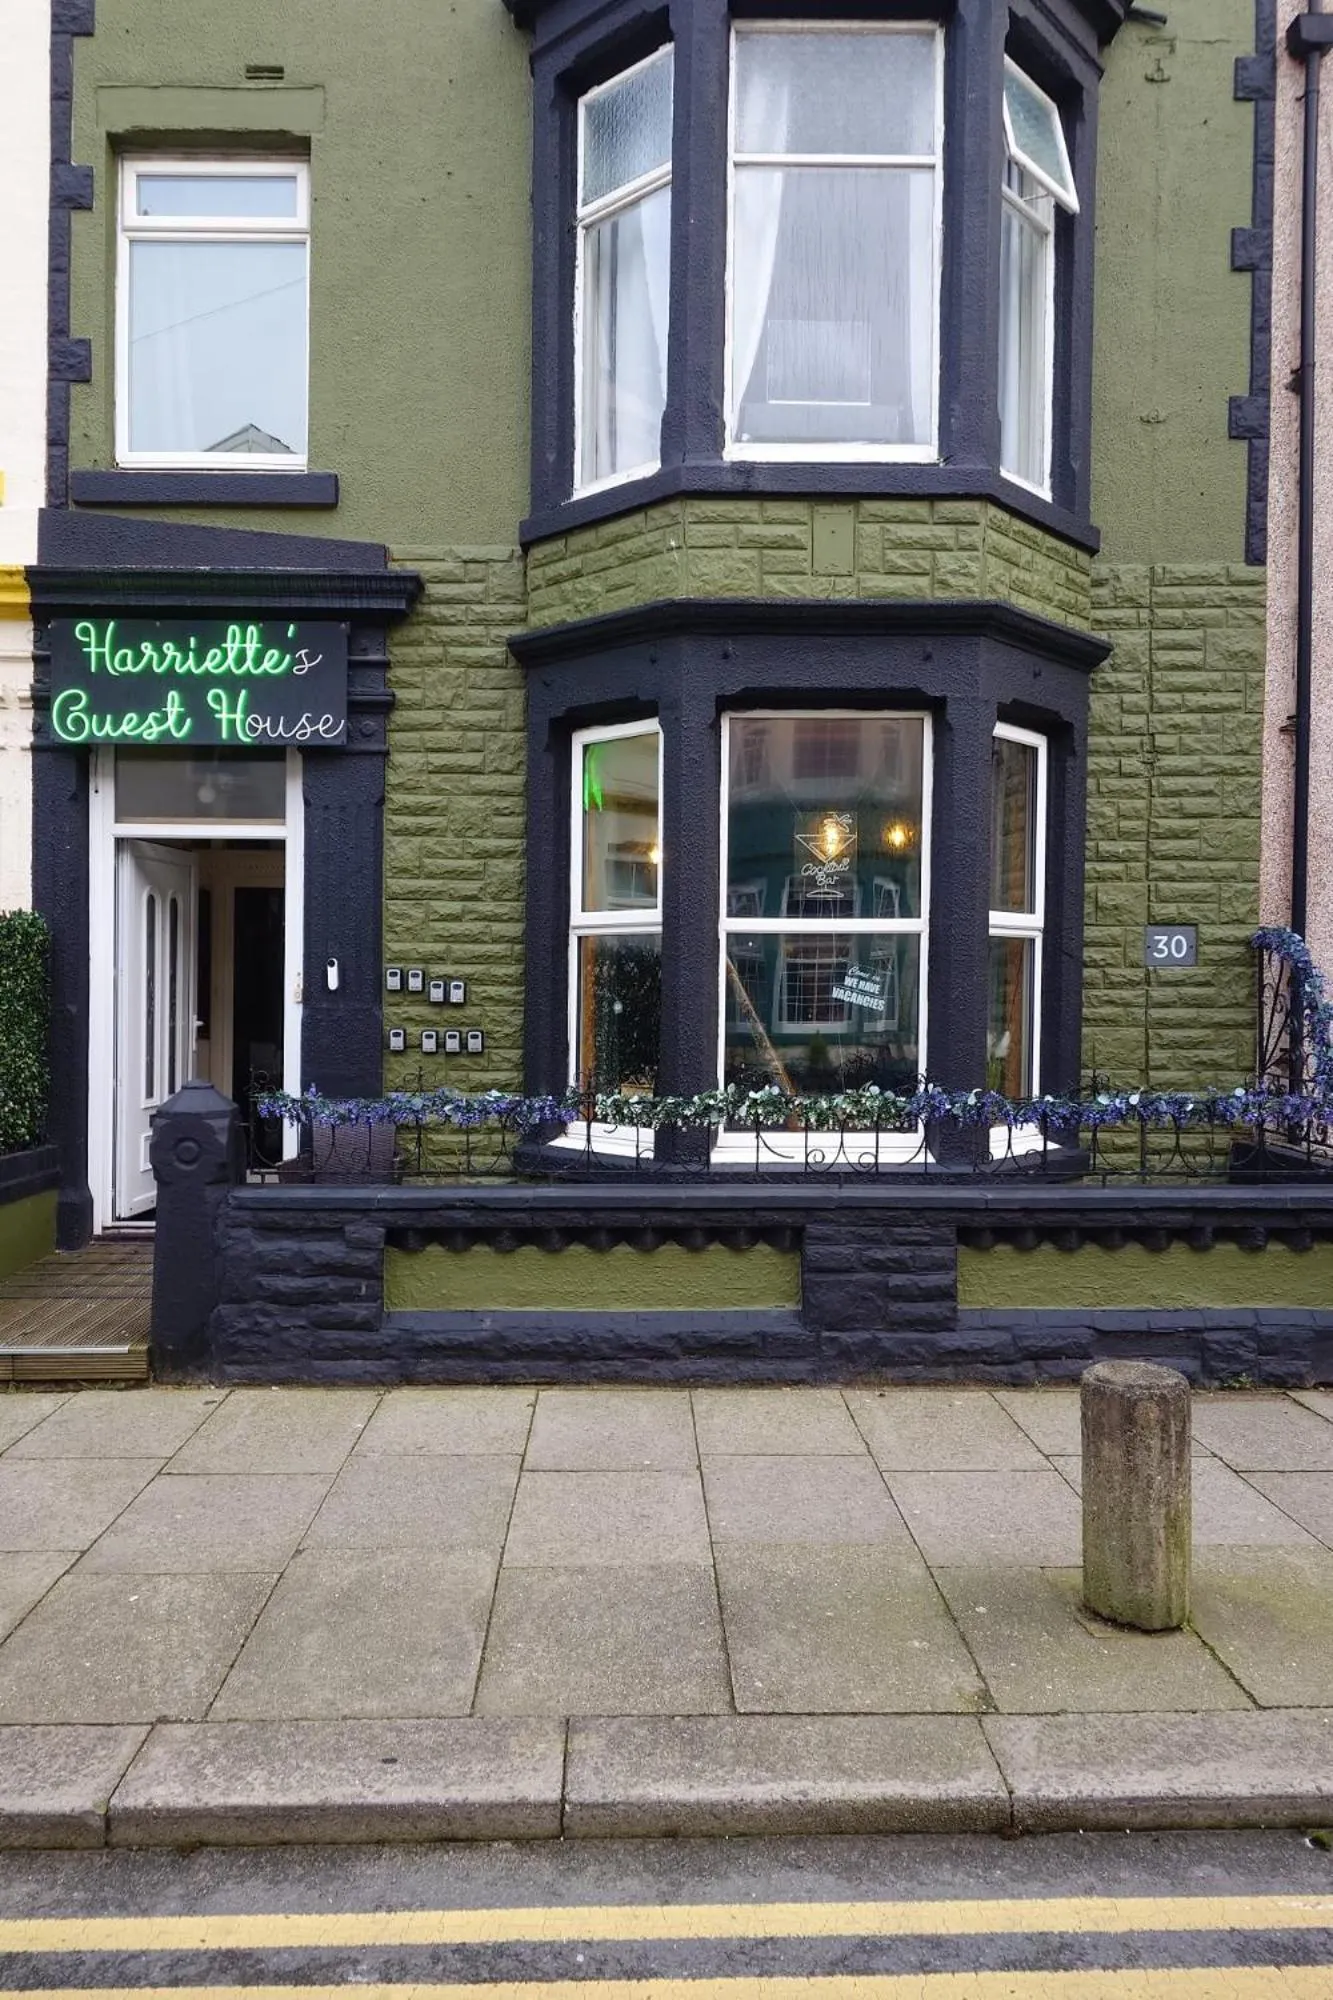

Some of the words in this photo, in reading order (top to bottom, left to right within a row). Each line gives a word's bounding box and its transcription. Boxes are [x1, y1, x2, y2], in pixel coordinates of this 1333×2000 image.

[75, 620, 323, 676] Harriette's
[52, 688, 192, 742] Guest
[207, 688, 345, 742] House
[801, 857, 850, 876] Cocktail
[815, 872, 840, 886] Bar
[1152, 935, 1187, 958] 30
[844, 975, 859, 989] WE
[858, 980, 881, 994] HAVE
[832, 986, 886, 1011] VACANCIES
